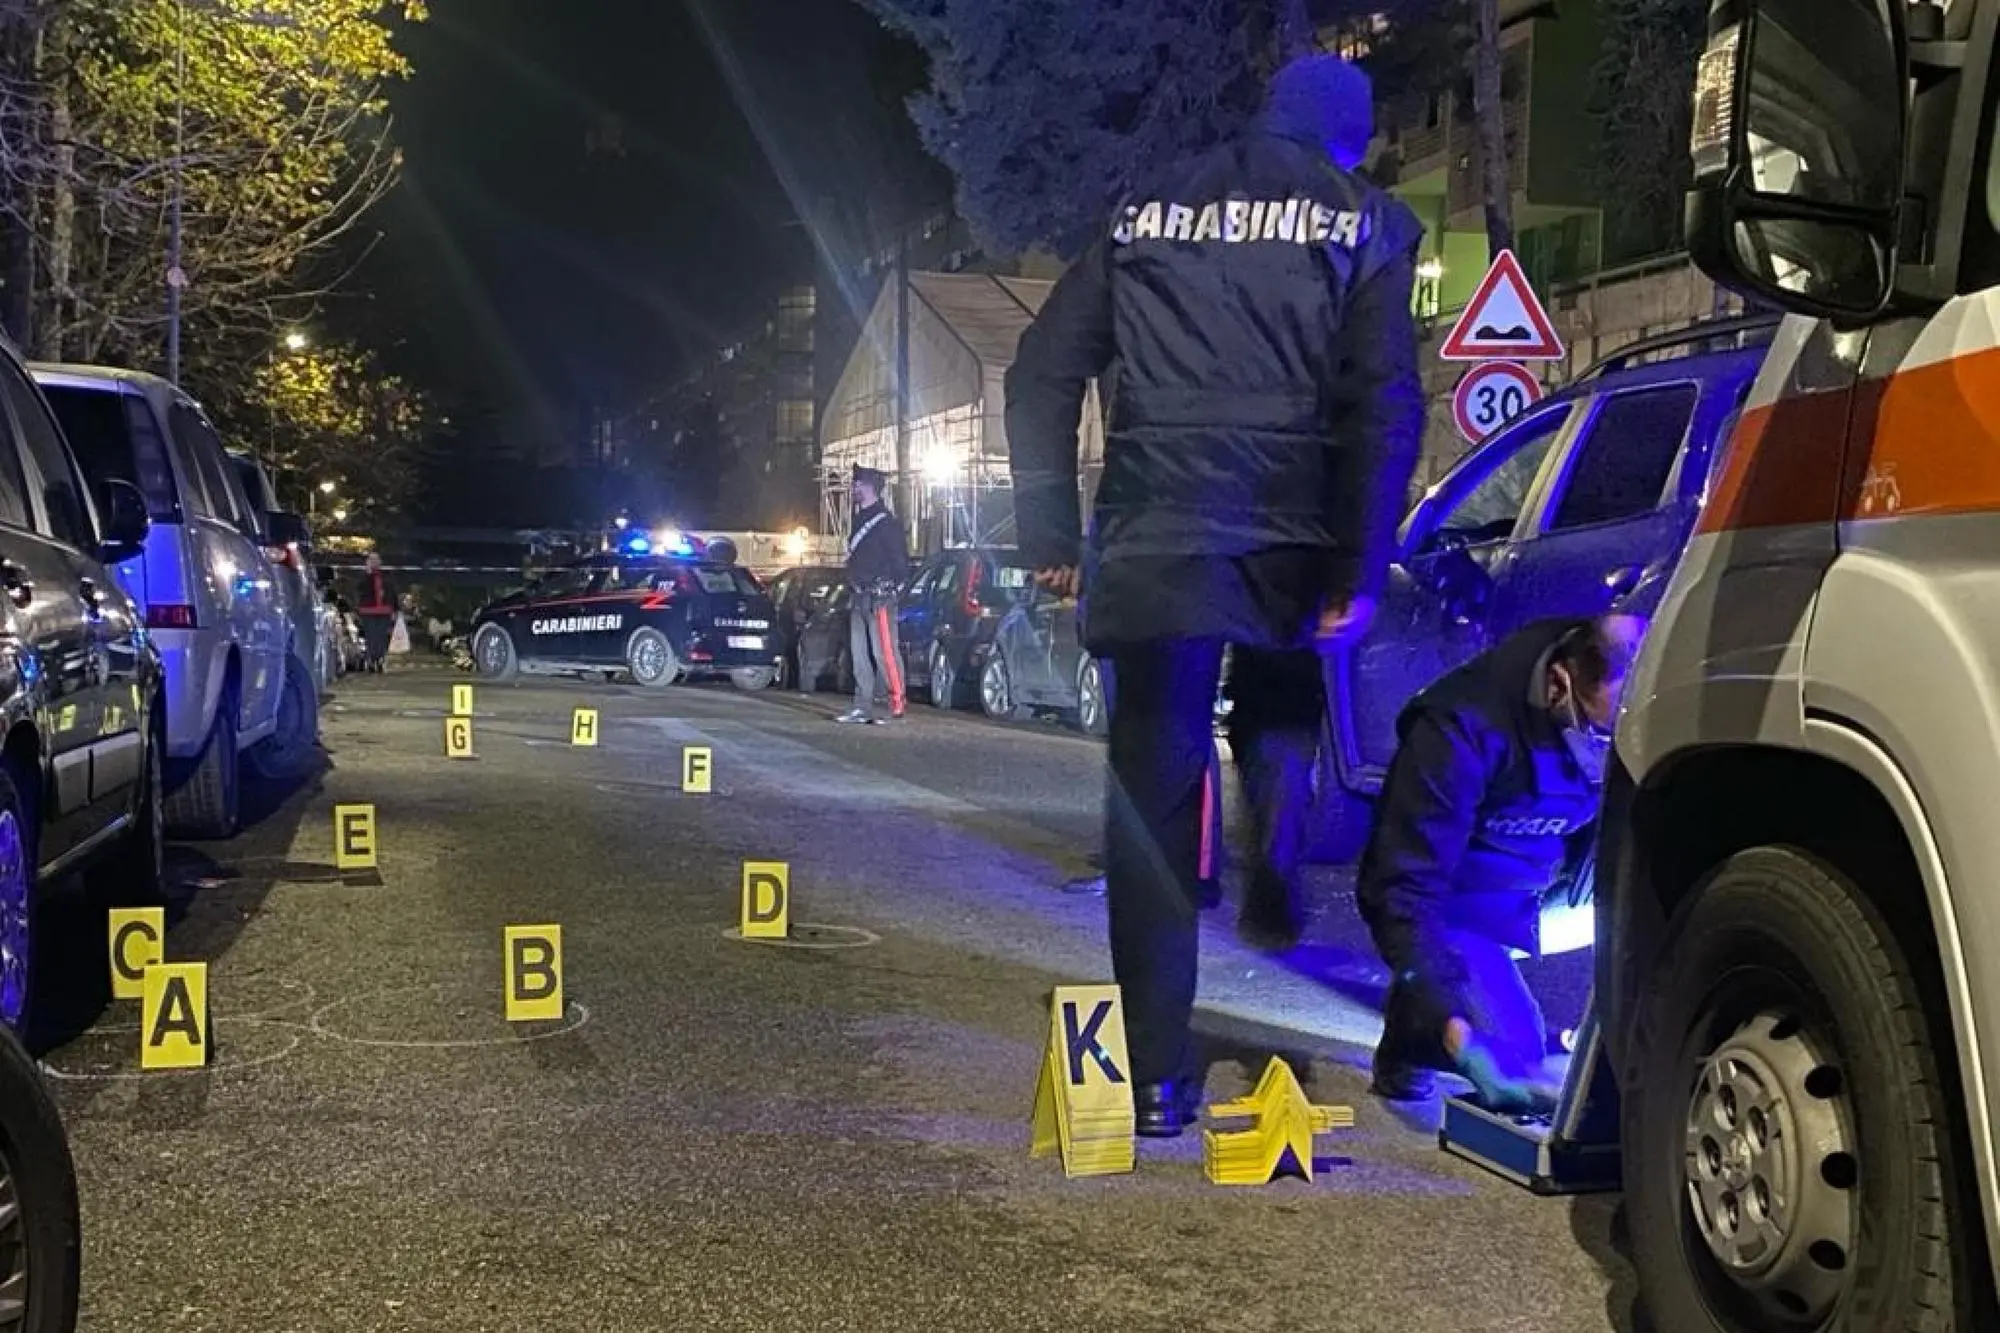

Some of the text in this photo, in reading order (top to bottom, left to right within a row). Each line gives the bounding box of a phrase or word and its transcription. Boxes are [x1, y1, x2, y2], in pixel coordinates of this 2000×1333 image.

[1476, 386, 1523, 425] 30
[532, 613, 622, 635] CARABINIERI
[452, 724, 467, 750] G
[576, 714, 594, 739] H
[688, 754, 706, 783] F
[342, 813, 371, 856] E
[748, 873, 784, 923] D
[114, 920, 158, 980] C
[512, 937, 557, 1001] B
[150, 976, 202, 1046] A
[1062, 1000, 1126, 1086] K
